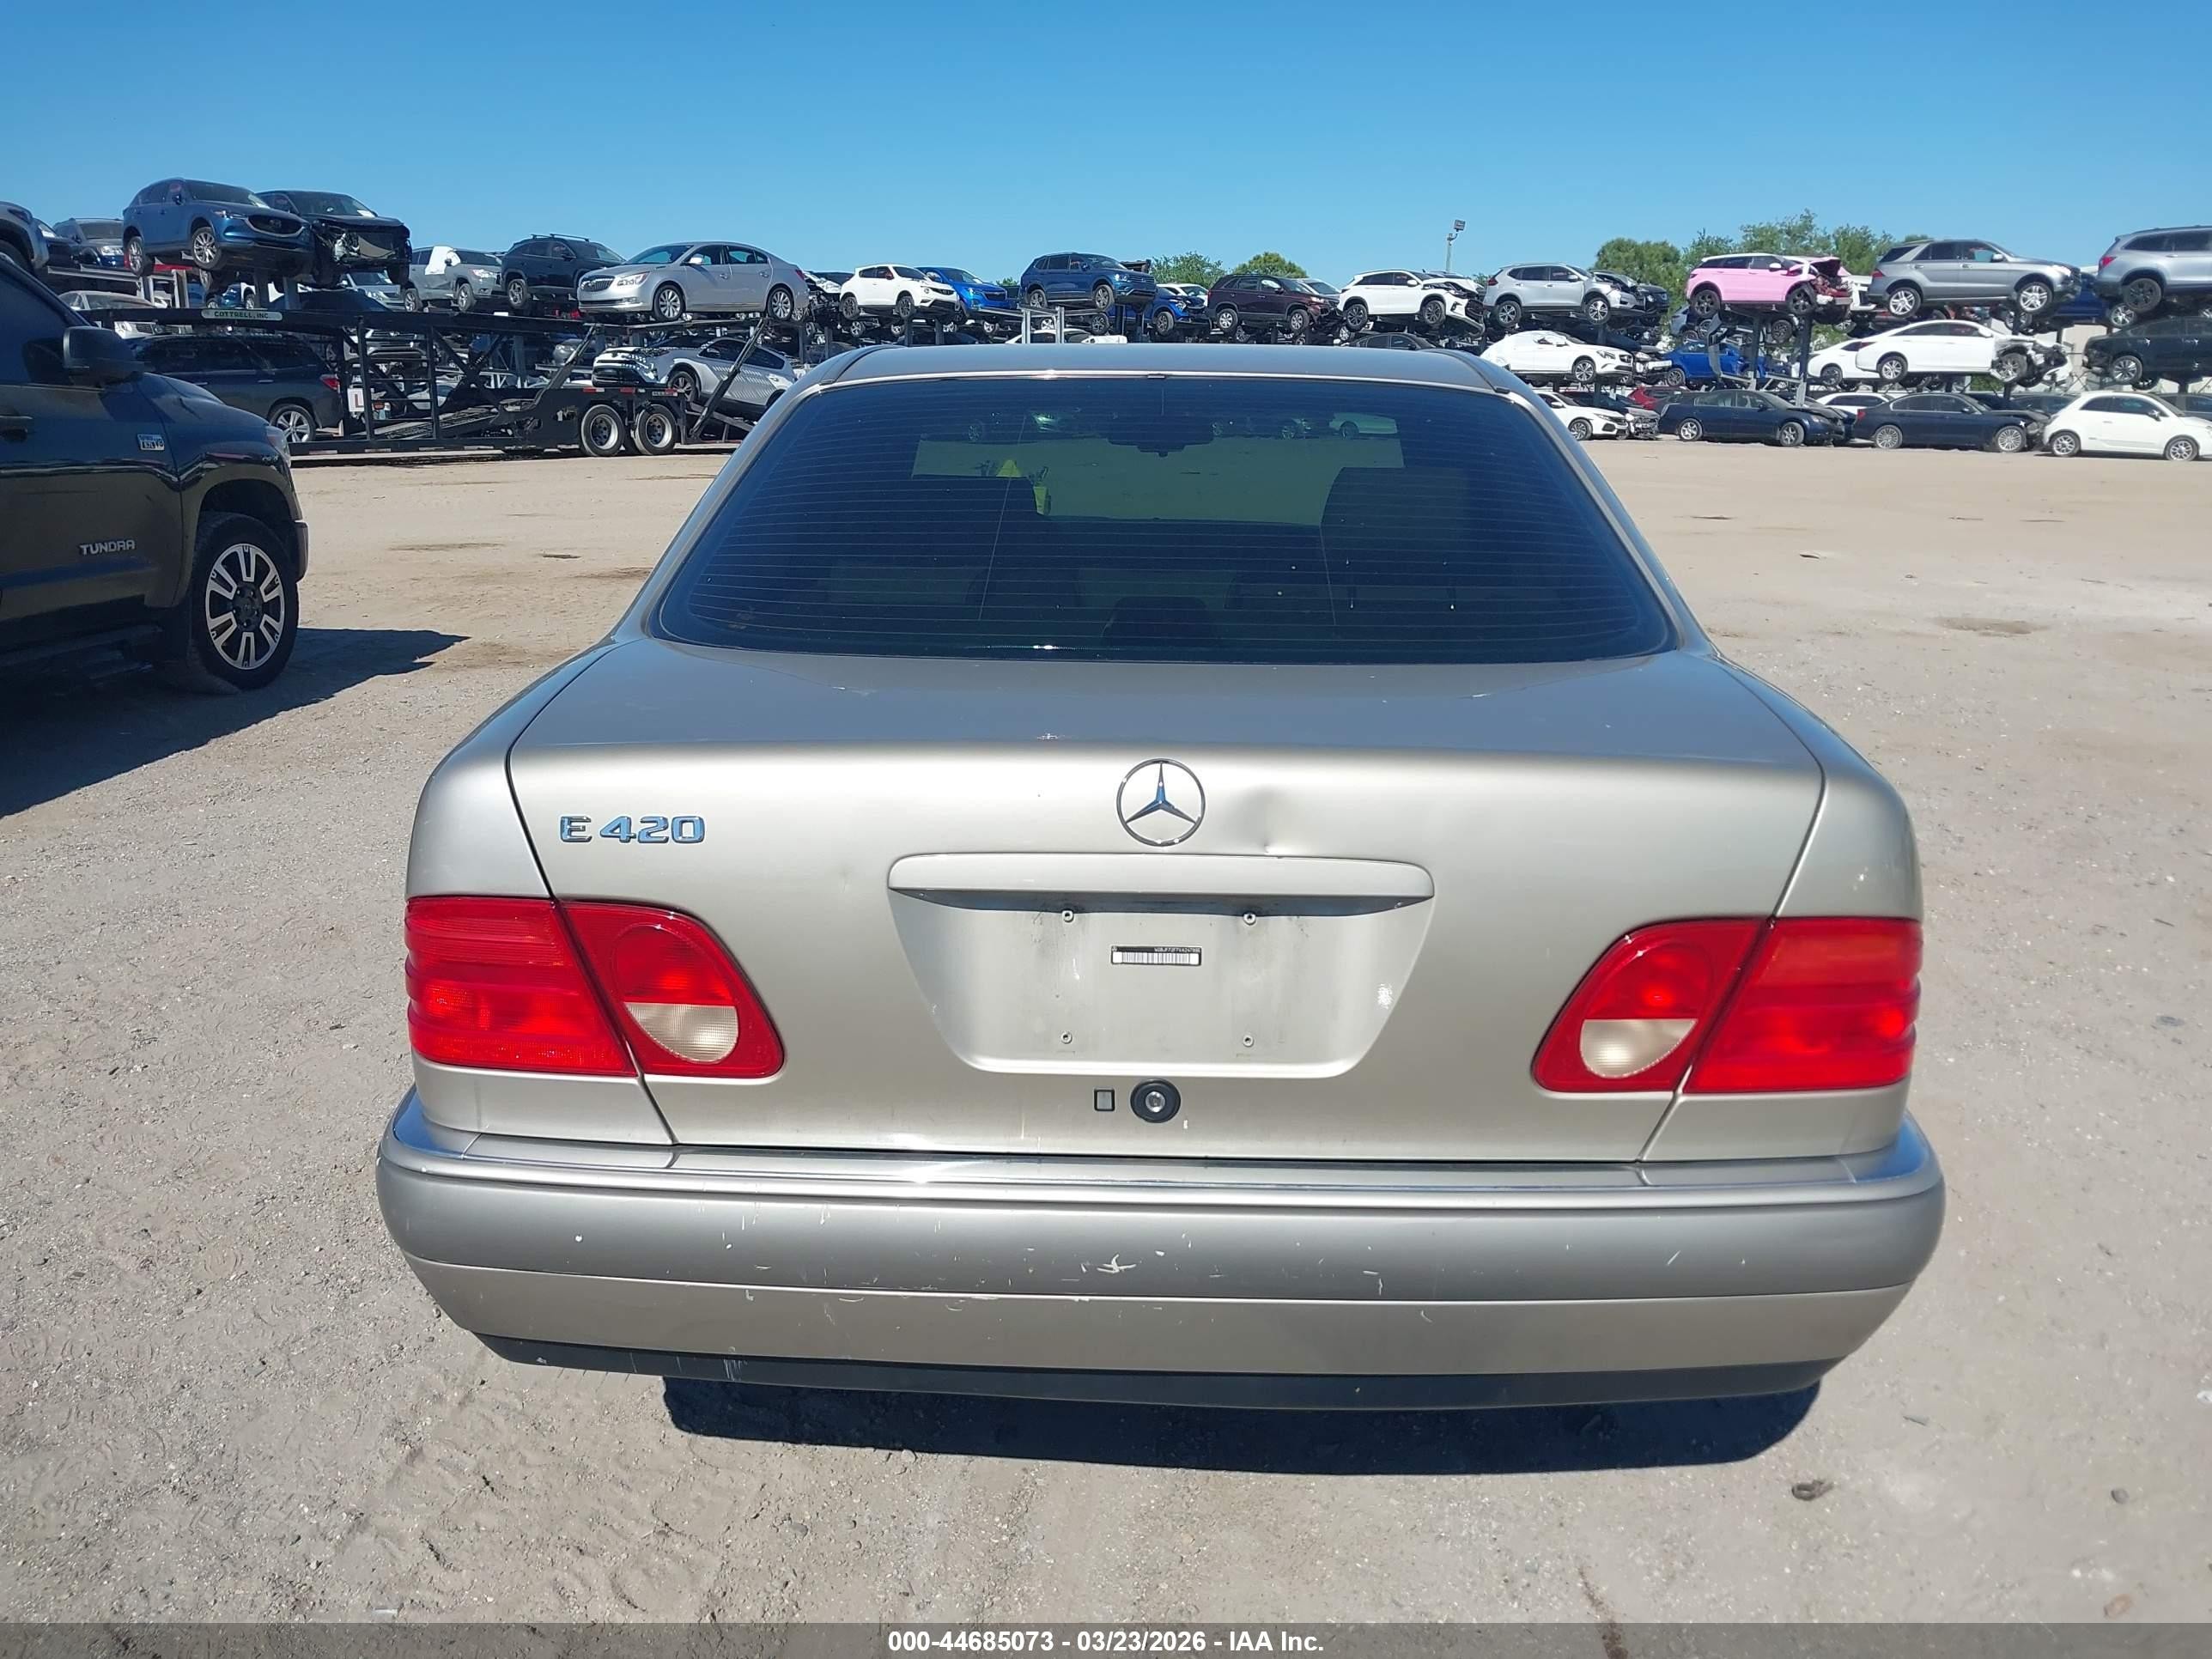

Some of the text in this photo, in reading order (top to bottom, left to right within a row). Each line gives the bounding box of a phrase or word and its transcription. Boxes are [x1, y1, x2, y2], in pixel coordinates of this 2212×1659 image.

[80, 539, 136, 555] TUNDRA
[560, 816, 705, 843] E 420
